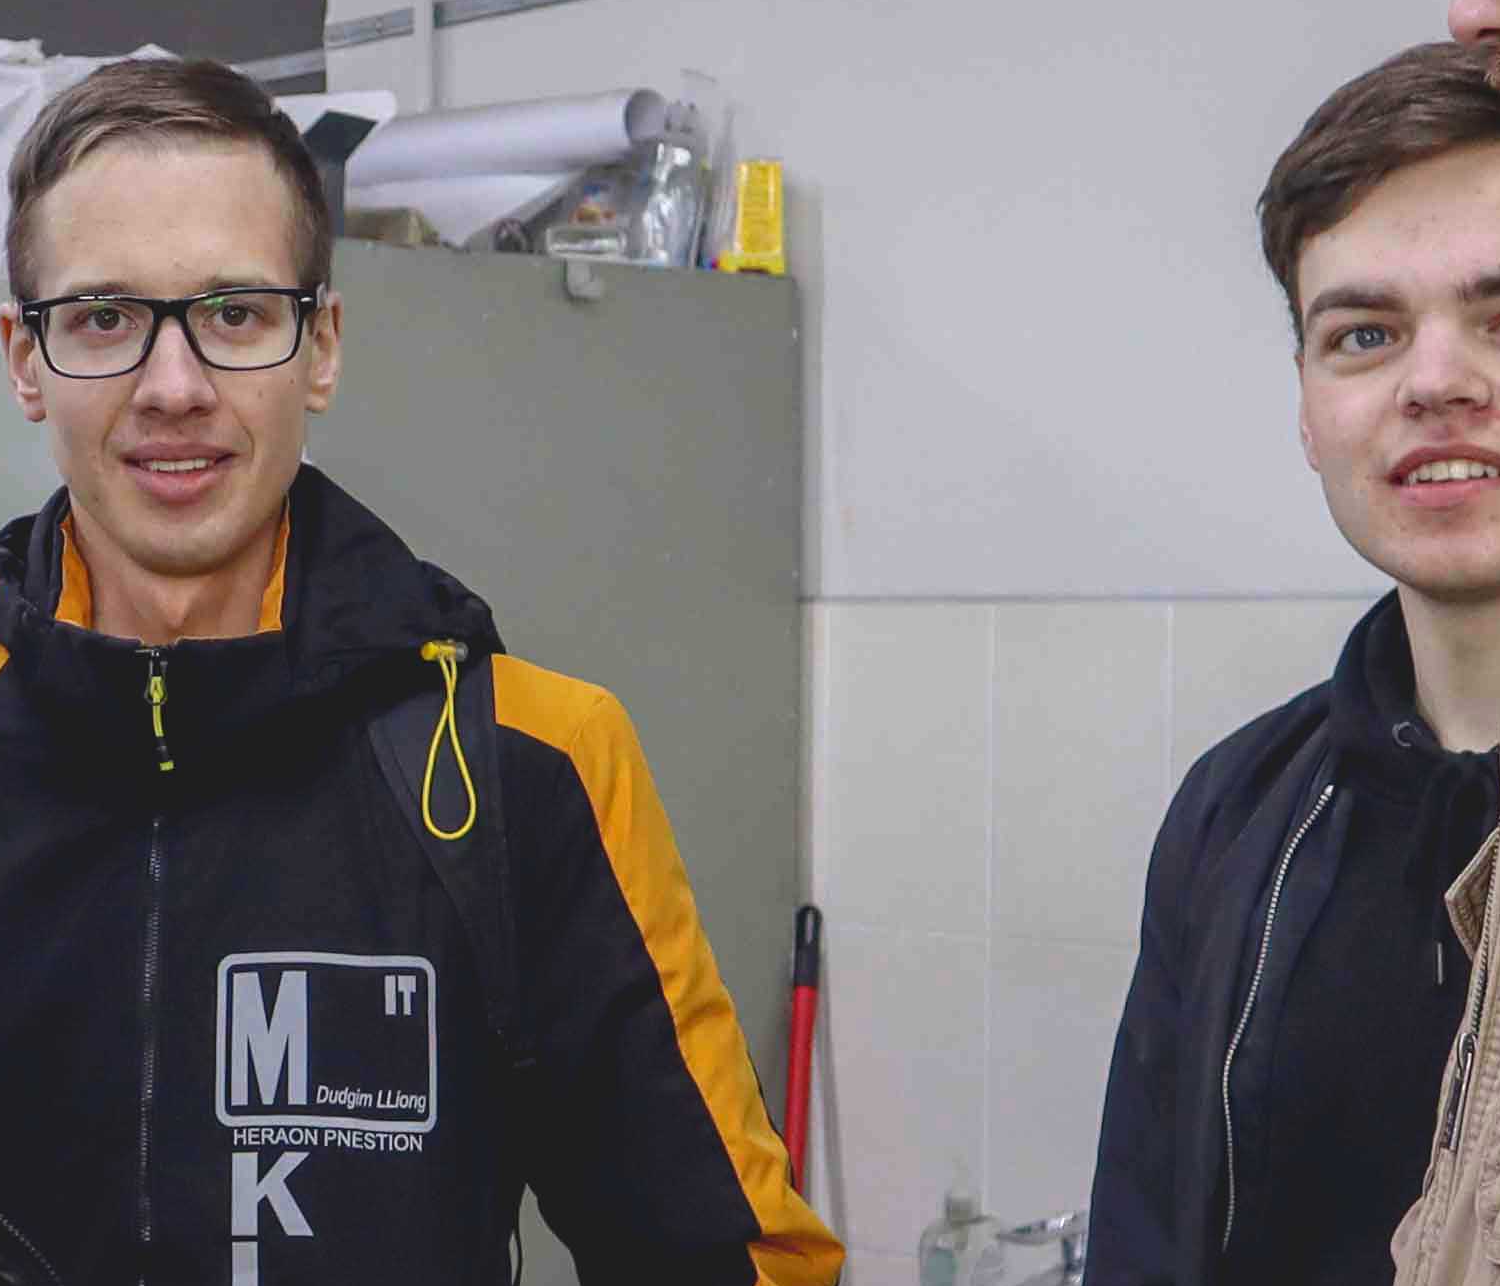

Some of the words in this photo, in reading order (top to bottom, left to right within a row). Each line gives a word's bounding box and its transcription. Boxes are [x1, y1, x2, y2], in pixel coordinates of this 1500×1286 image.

[384, 975, 417, 1016] IT
[231, 970, 308, 1106] M
[316, 1085, 373, 1110] Dudgim
[233, 1128, 318, 1147] HERAON
[323, 1129, 423, 1152] PNESTION
